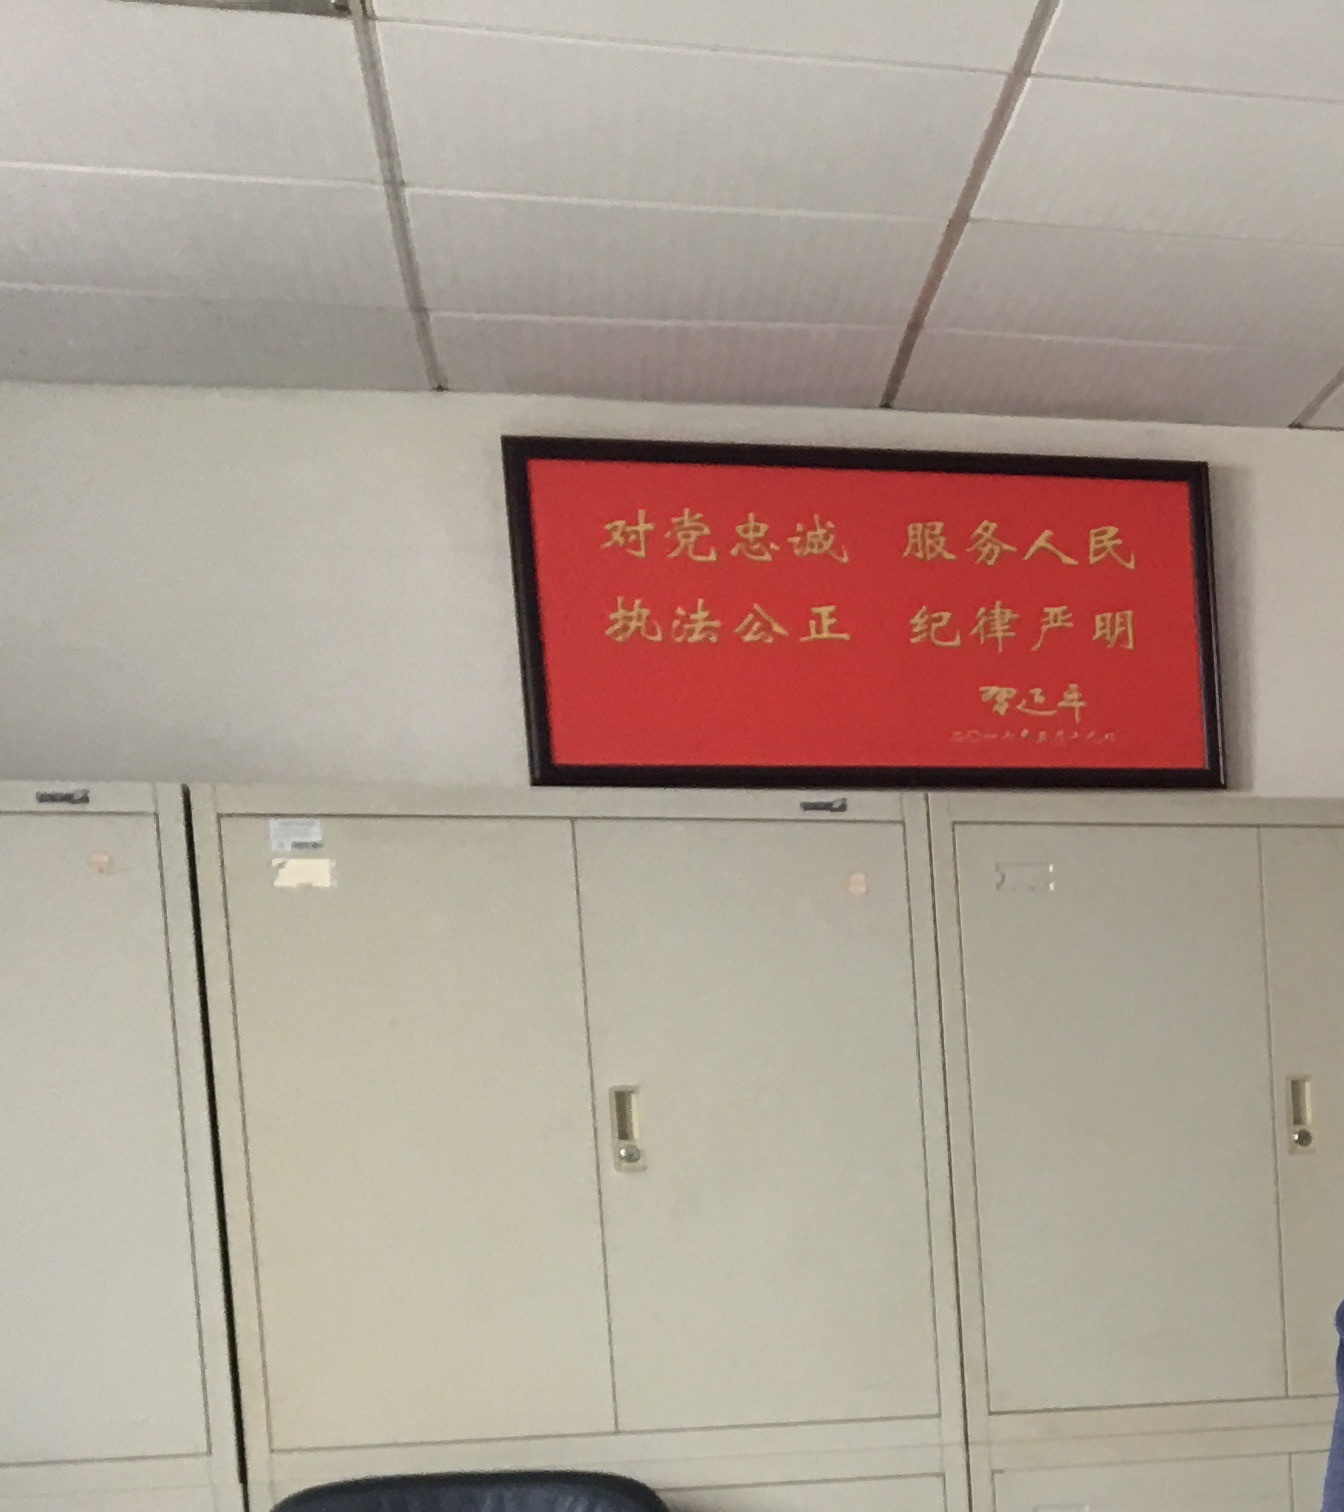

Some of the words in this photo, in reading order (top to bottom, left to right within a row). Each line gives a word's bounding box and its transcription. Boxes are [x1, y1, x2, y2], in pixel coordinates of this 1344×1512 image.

[600, 508, 851, 565] 对党忠诚
[902, 519, 1137, 570] 服务人民
[605, 596, 852, 645] 执法公正
[909, 600, 1136, 652] 纪律严明
